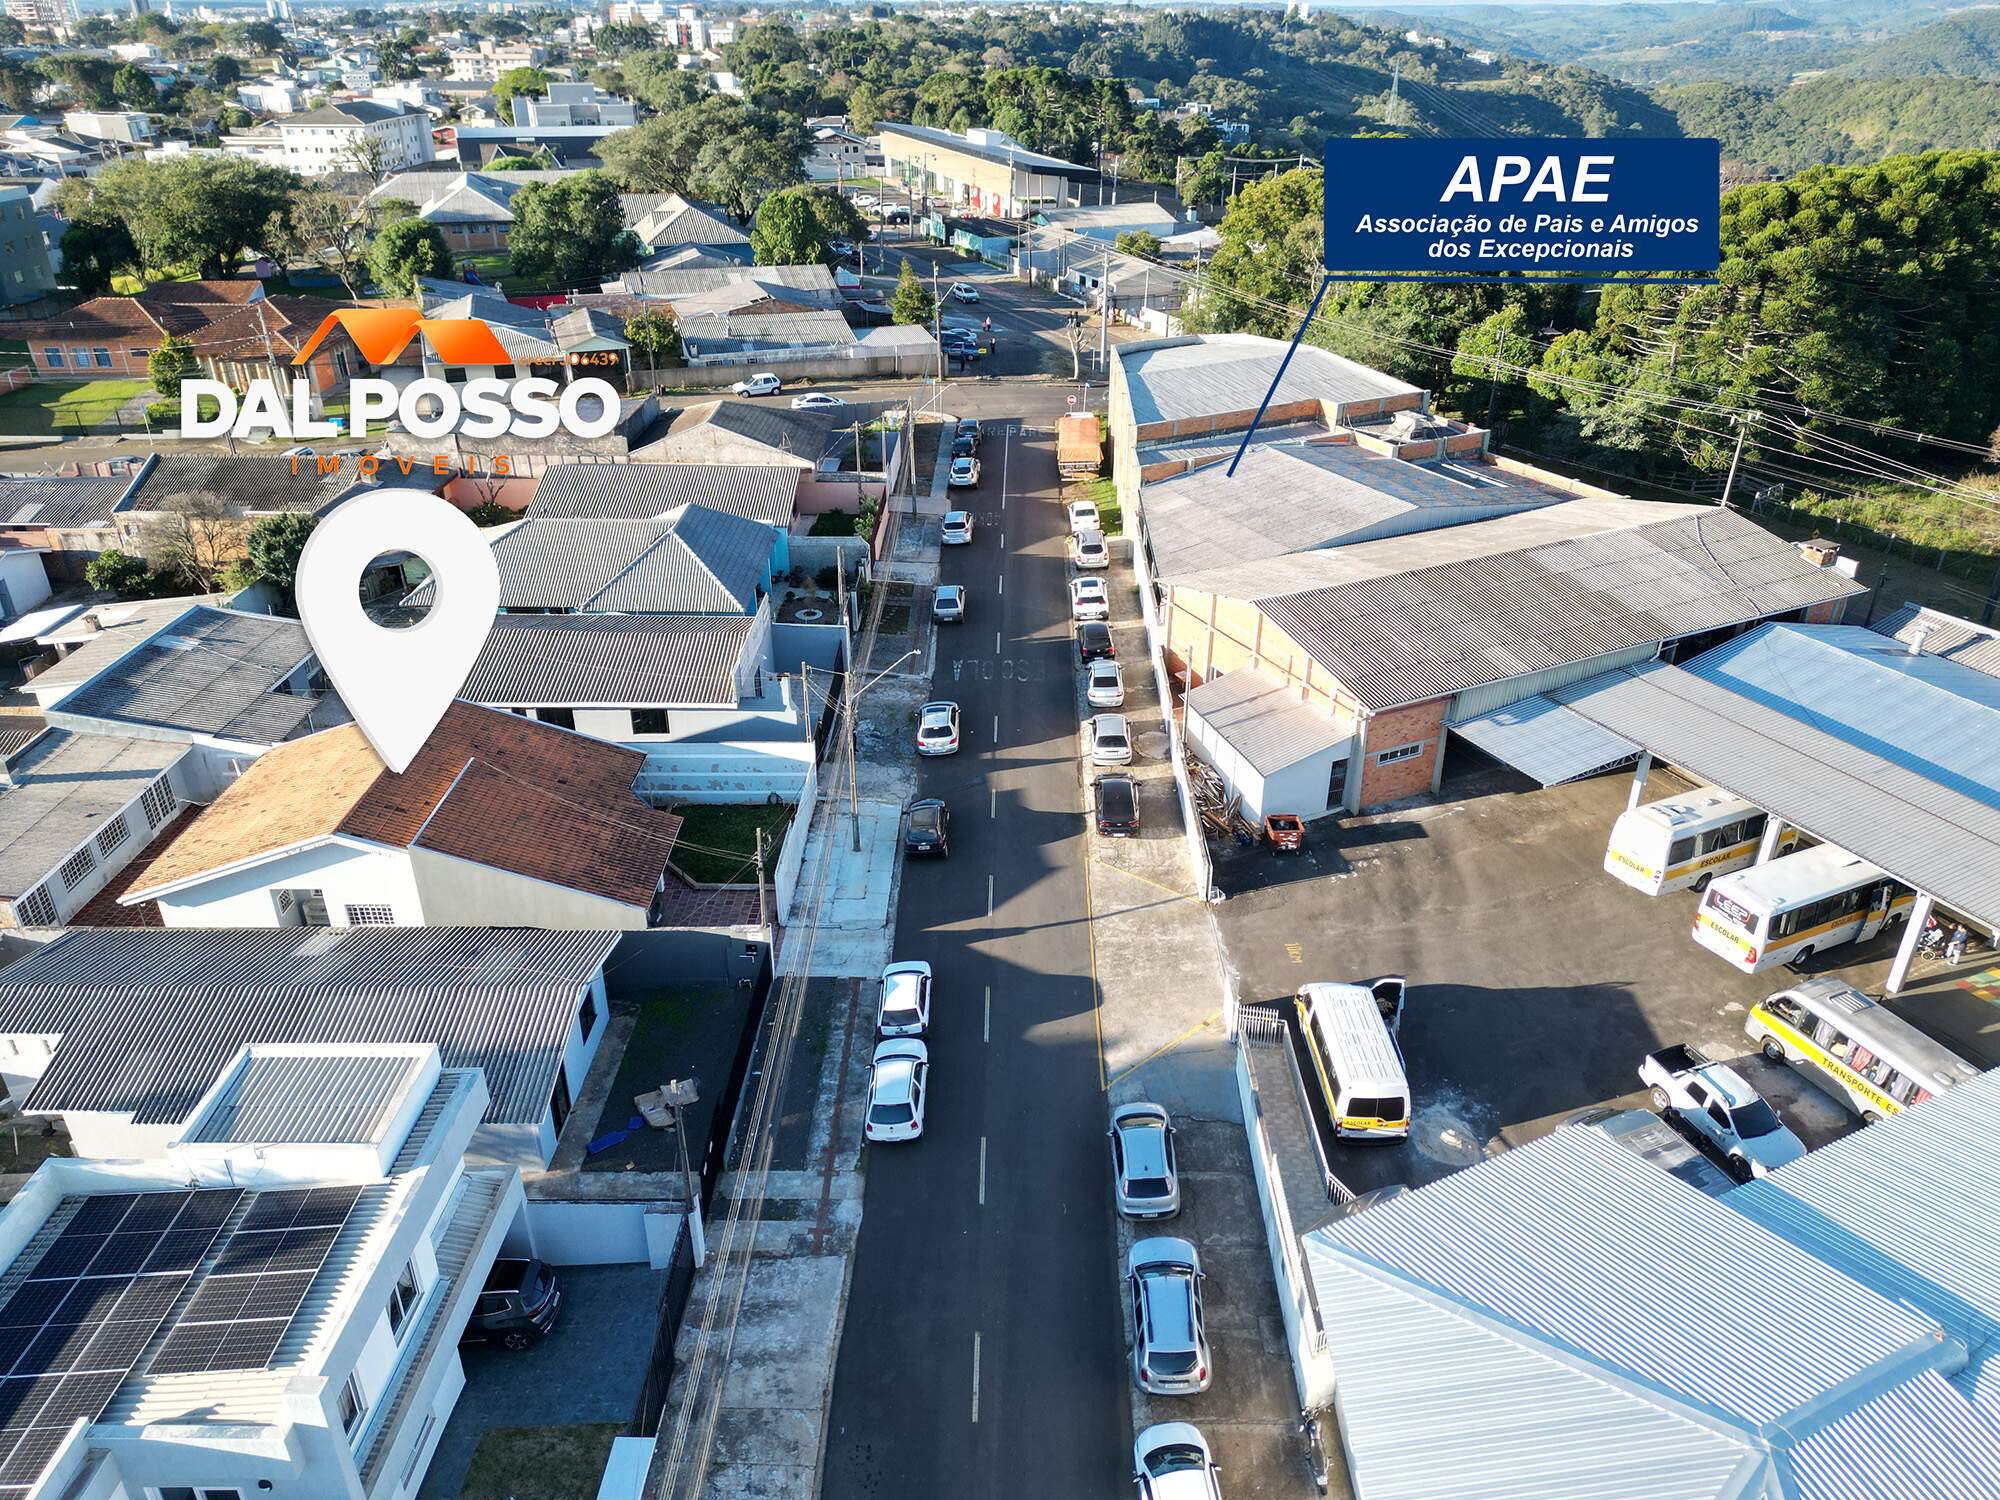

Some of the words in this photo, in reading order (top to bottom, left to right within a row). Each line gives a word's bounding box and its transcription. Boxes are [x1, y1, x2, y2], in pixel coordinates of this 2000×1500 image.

[1618, 855, 1645, 873] ESCOLAR
[1700, 852, 1732, 868] ESCOLAR
[1710, 921, 1740, 944] ESCOLAR
[1822, 1057, 1882, 1105] TRANSPORTE
